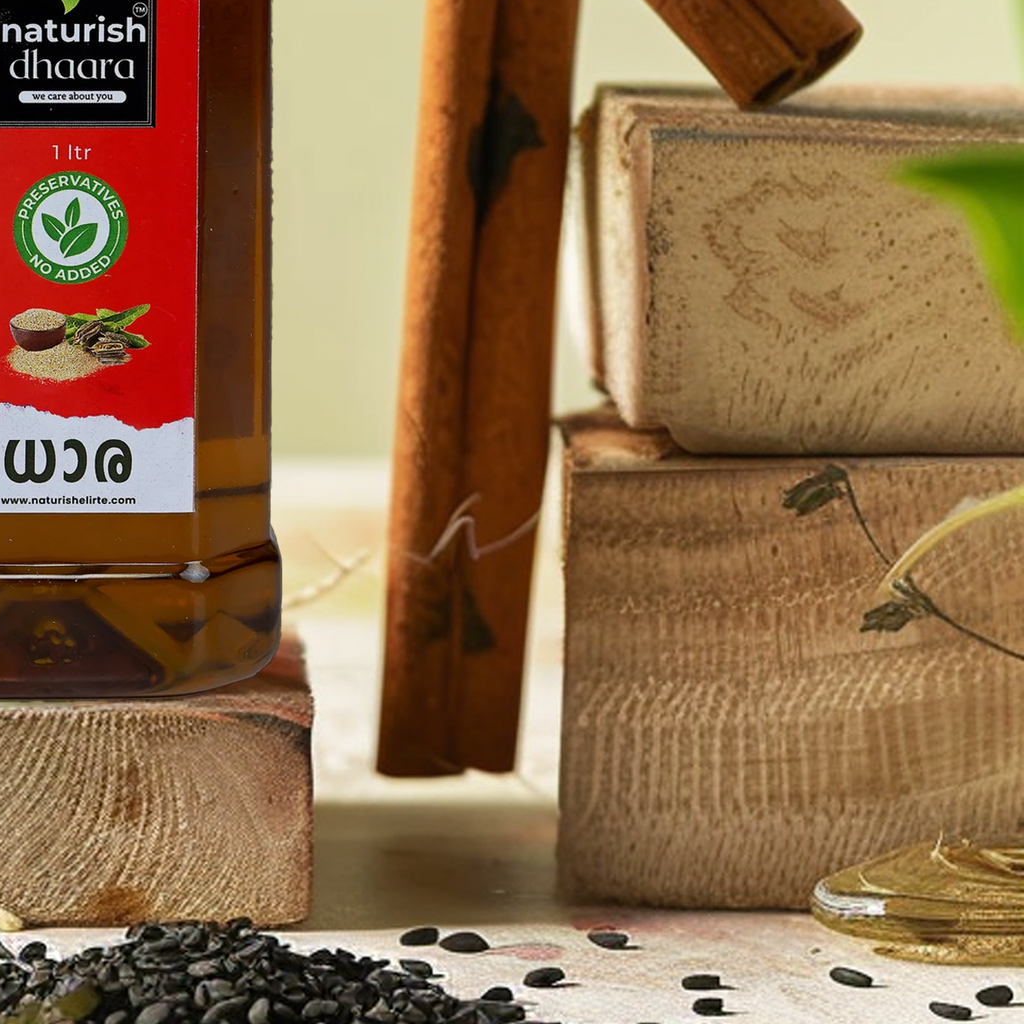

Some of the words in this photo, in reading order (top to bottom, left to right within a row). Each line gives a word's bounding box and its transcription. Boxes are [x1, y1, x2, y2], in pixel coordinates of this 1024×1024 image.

[2, 15, 146, 42] naturish
[9, 48, 135, 79] dhaara
[32, 93, 45, 101] we
[47, 93, 67, 101] care
[68, 91, 95, 101] about
[96, 93, 113, 103] you
[52, 144, 59, 160] 1
[68, 144, 92, 160] ltr
[18, 175, 124, 220] PRESERVATIVES
[29, 254, 52, 274] NO
[54, 255, 111, 281] ADDED
[4, 438, 133, 483] ധാര
[1, 495, 136, 505] www.naturishelirte.com
